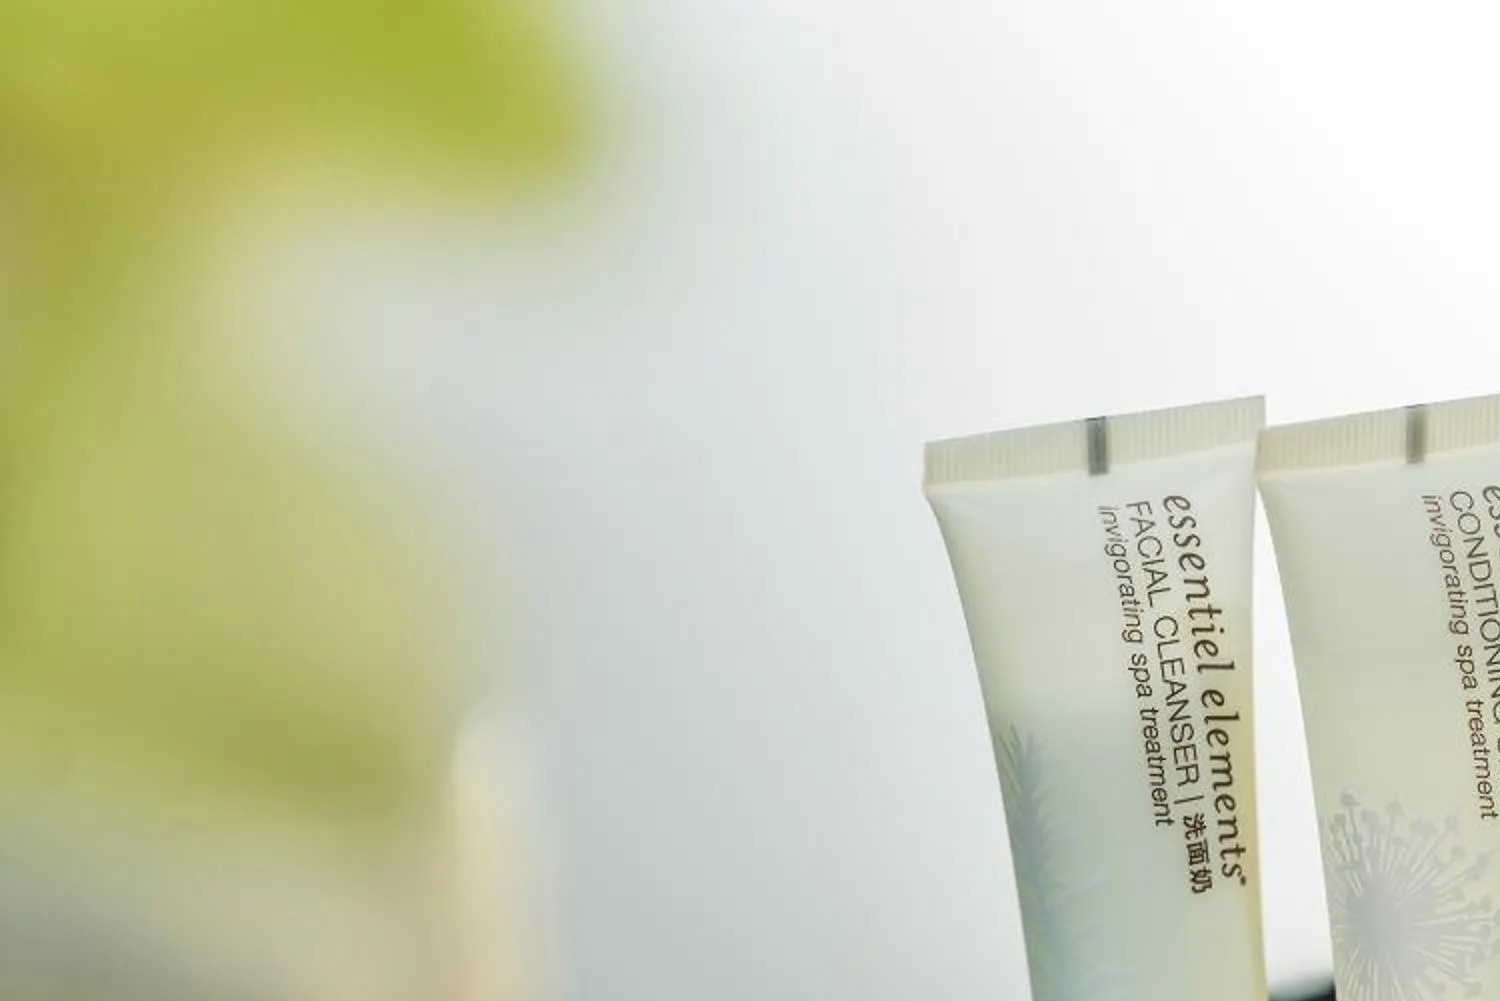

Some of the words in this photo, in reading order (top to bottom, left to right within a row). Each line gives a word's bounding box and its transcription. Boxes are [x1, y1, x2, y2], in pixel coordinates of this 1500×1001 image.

[1099, 505, 1147, 644] invigorating
[1163, 495, 1235, 675] essentiel
[1421, 494, 1475, 636] invigorating
[1126, 501, 1172, 607] FACIAL
[1153, 615, 1200, 786] CLEANSER
[1126, 653, 1155, 699] spa
[1455, 644, 1481, 692] spa
[1140, 707, 1174, 828] treatment
[1464, 700, 1499, 820] treatment
[1182, 813, 1214, 895] 洗面奶
